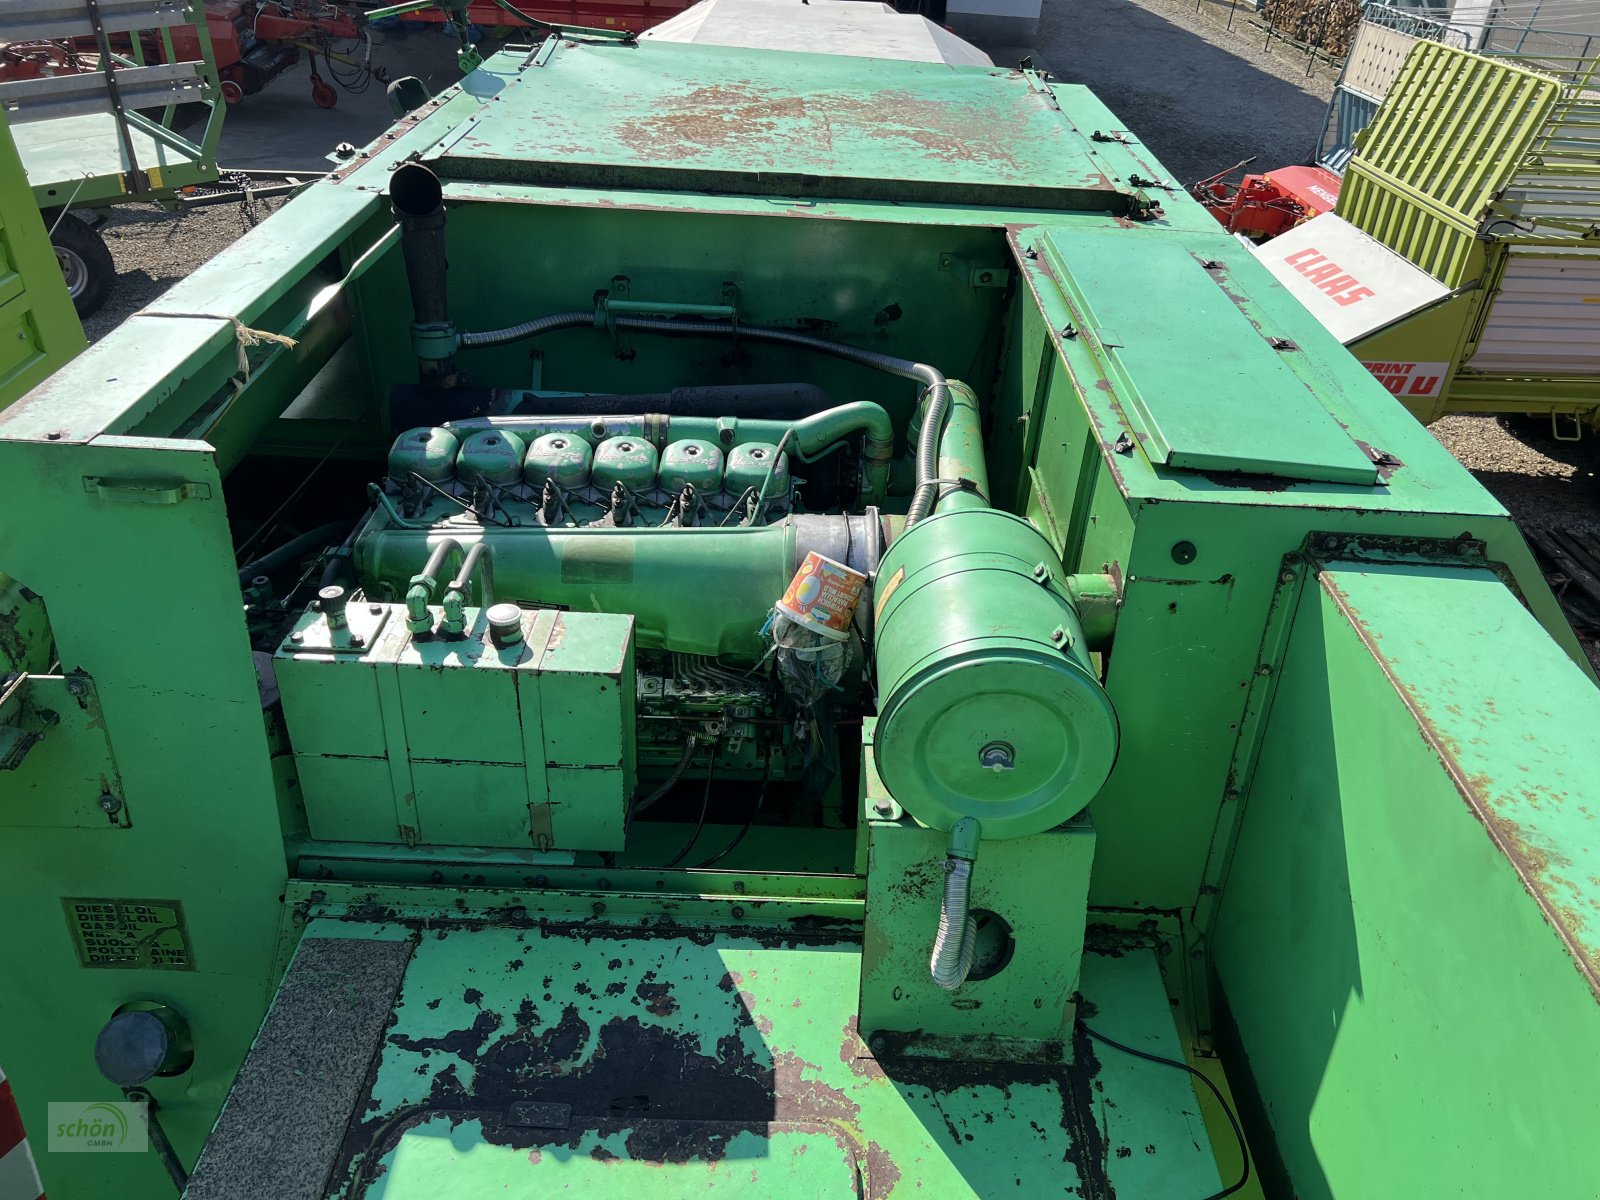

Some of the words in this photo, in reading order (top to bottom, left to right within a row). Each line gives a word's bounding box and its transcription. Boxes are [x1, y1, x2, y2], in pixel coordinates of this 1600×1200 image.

[1284, 247, 1376, 307] CLAAS
[1408, 376, 1440, 395] U
[78, 913, 164, 924] DIESLOIL
